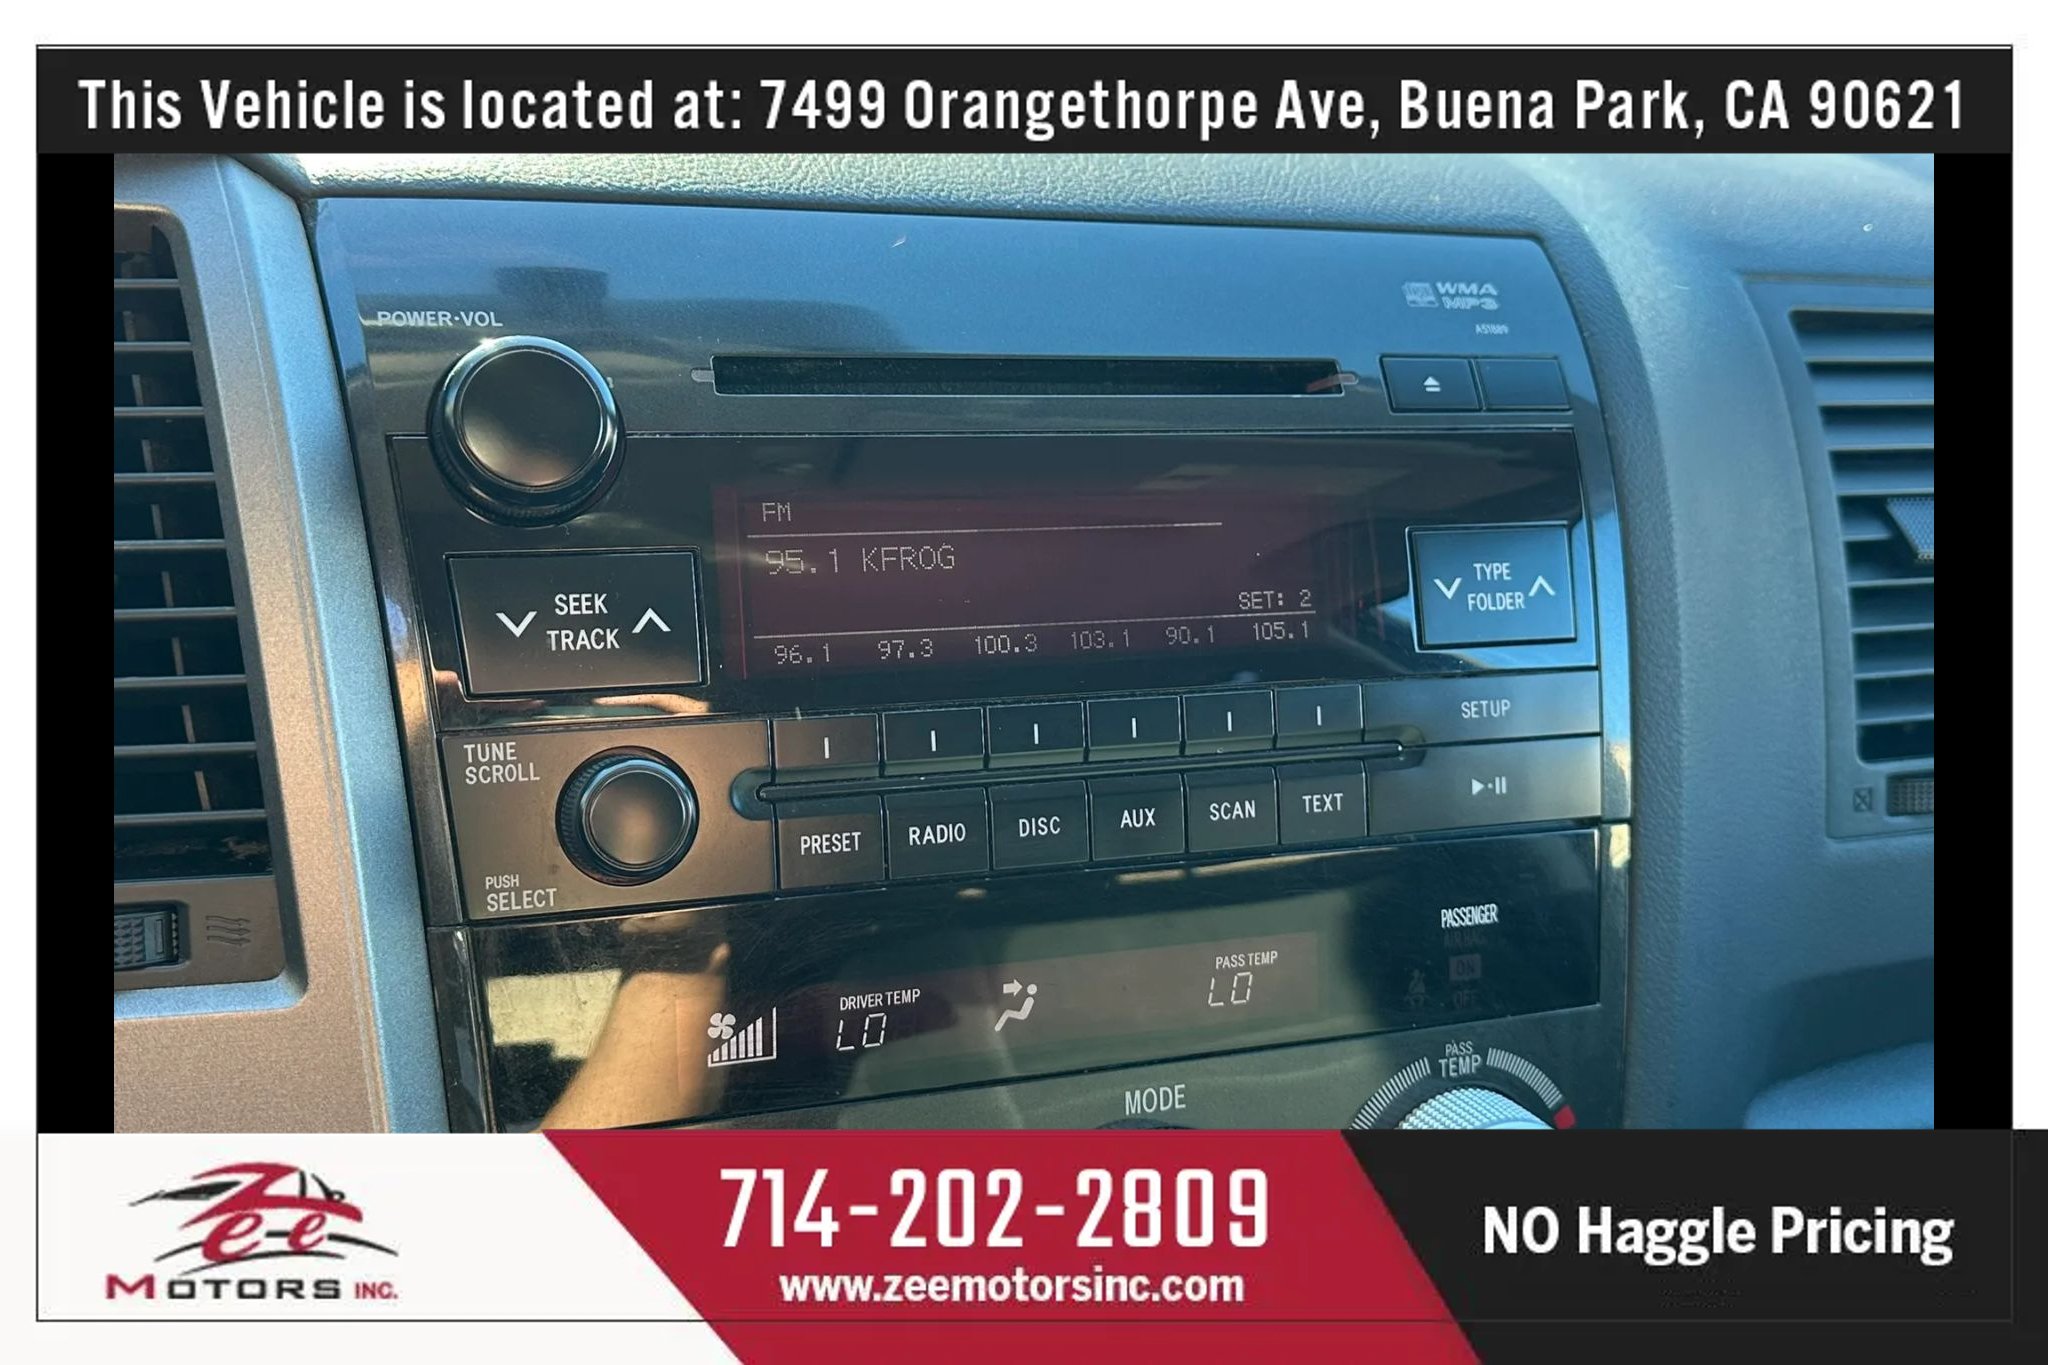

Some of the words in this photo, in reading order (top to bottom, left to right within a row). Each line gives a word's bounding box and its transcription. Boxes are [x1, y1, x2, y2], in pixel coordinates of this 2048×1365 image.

[1436, 281, 1499, 296] WMA
[762, 502, 792, 523] FM
[765, 548, 839, 575] 95.1
[861, 544, 957, 573] KFROG
[1473, 562, 1512, 581] TYPE
[554, 593, 609, 616] SEEK
[1239, 591, 1286, 610] SET:
[1299, 589, 1312, 608] 2
[1467, 592, 1525, 612] FOLDER
[547, 628, 620, 651] TRACK
[774, 643, 832, 664] 96.1
[878, 638, 934, 660] 97.3
[974, 634, 1039, 656] 100.3
[1071, 629, 1132, 650] 103.1
[1165, 625, 1217, 646] 90.1
[1252, 619, 1311, 641] 105.1
[1461, 700, 1512, 720] SETUP
[464, 742, 517, 763] TUNE
[465, 763, 541, 785] SCROLL
[1209, 800, 1256, 822] SCAN
[1302, 793, 1344, 814] TEXT
[1018, 816, 1061, 838] DISC
[1120, 807, 1156, 829] AUX
[800, 831, 862, 855] PRESET
[908, 823, 967, 846] RADIO
[485, 874, 520, 890] PUSH
[486, 888, 558, 913] SELECT
[1441, 903, 1498, 929] PASSENGER
[1215, 954, 1245, 969] PASS
[1246, 950, 1279, 967] TEMP
[839, 992, 884, 1011] DRIVER
[885, 988, 921, 1006] TEMP
[1445, 1041, 1473, 1056] PASS
[1438, 1054, 1482, 1078] TEMP
[1125, 1084, 1187, 1116] MODE
